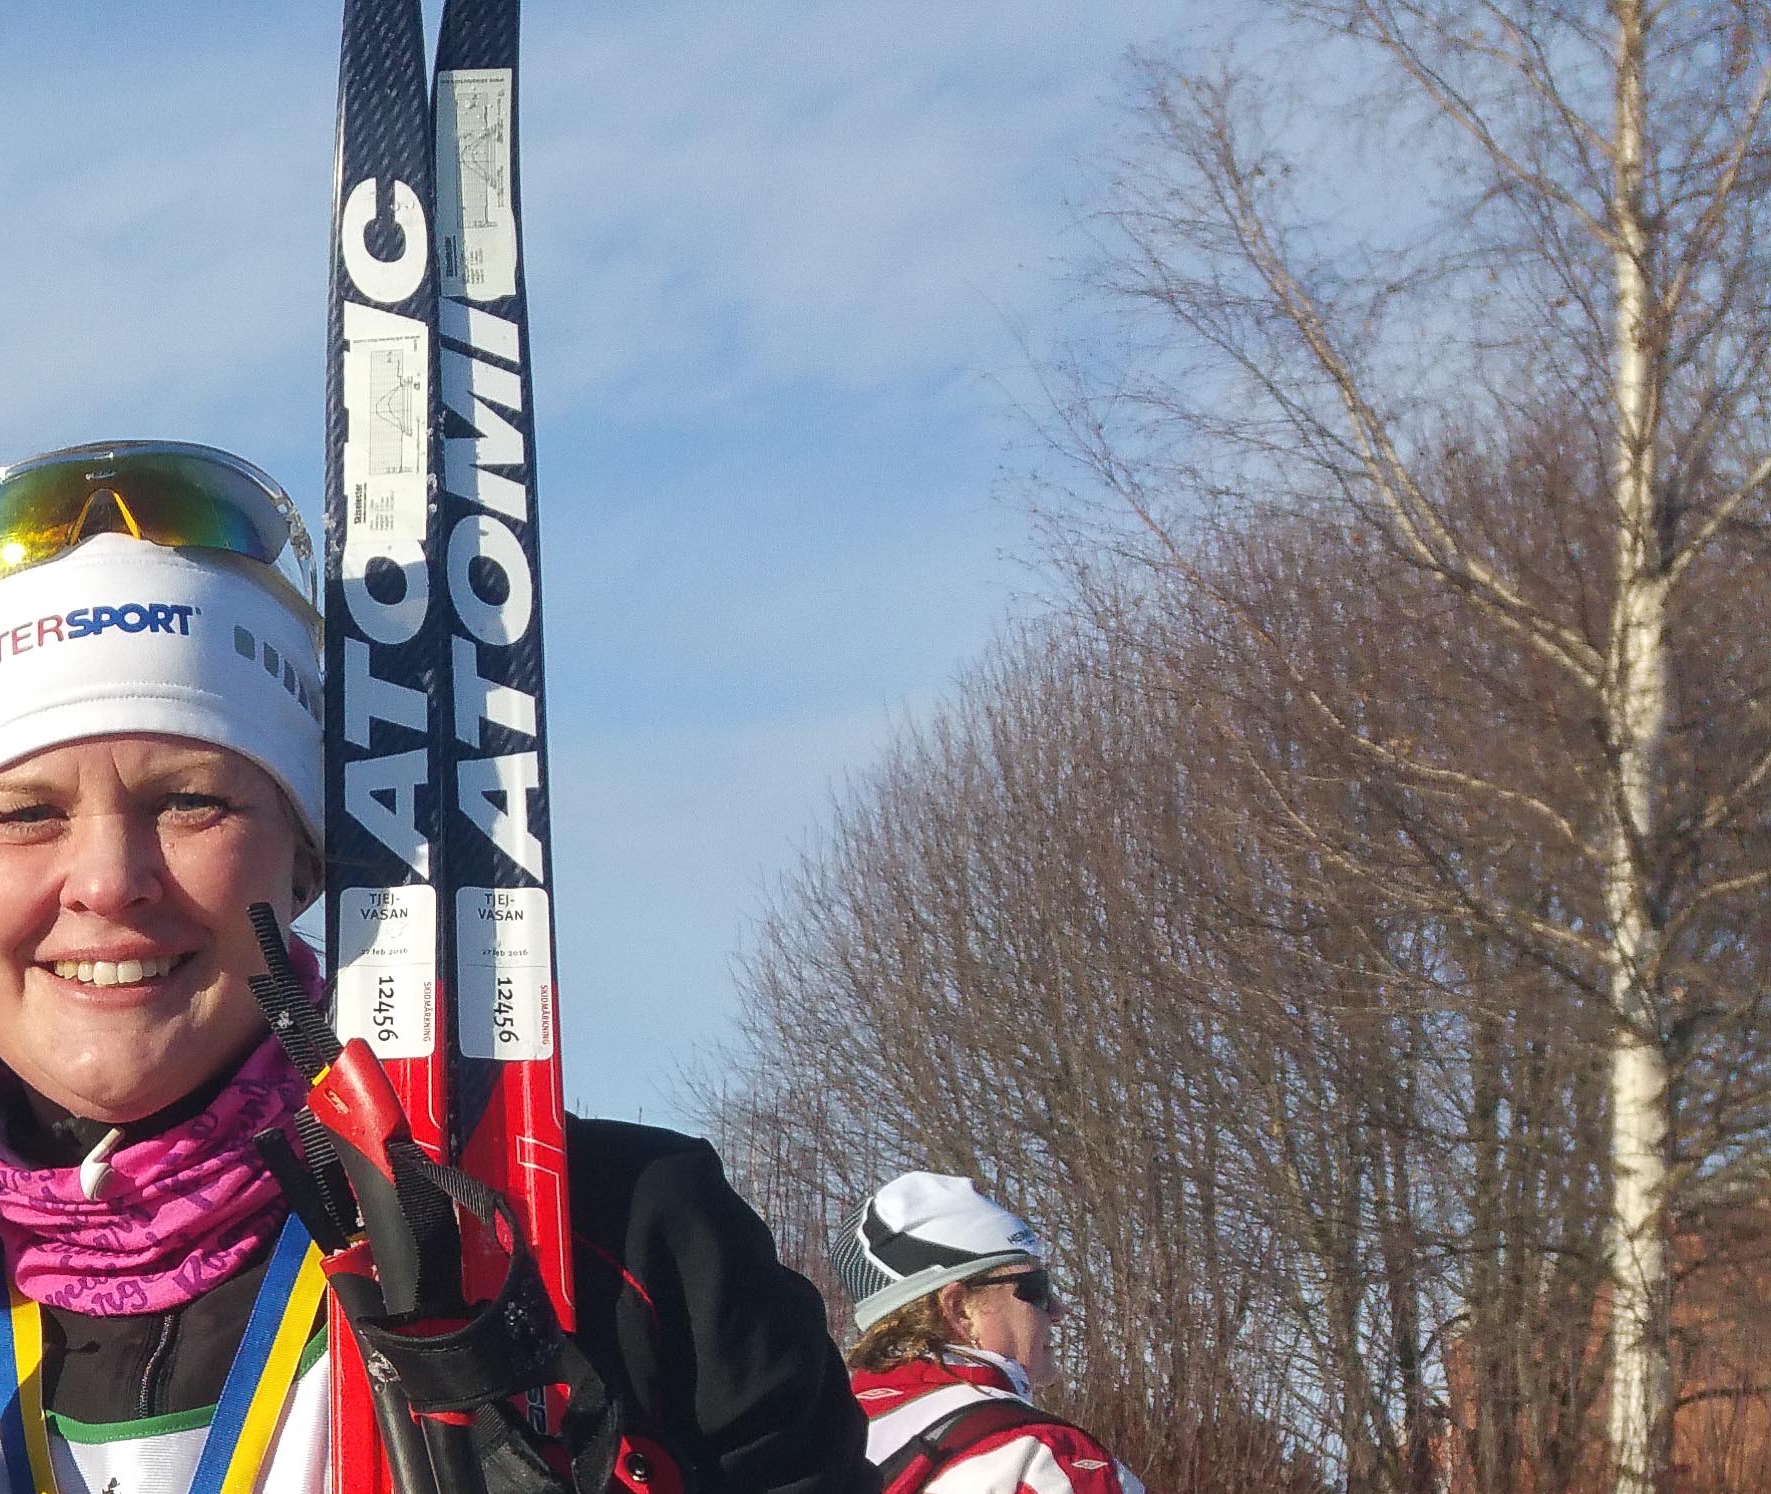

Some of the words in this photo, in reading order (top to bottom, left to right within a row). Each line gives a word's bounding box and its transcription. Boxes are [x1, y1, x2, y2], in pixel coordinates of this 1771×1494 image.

[341, 176, 430, 881] ATOC
[438, 285, 544, 884] ATOMI
[369, 892, 400, 908] TJEJ-
[484, 893, 515, 908] TJEJ-
[360, 908, 408, 921] VASAN
[477, 908, 524, 921] VASAN
[371, 947, 386, 957] feb
[388, 947, 409, 957] 2016
[508, 948, 529, 958] 2016
[372, 975, 399, 1042] 12456
[493, 976, 520, 1044] 12456
